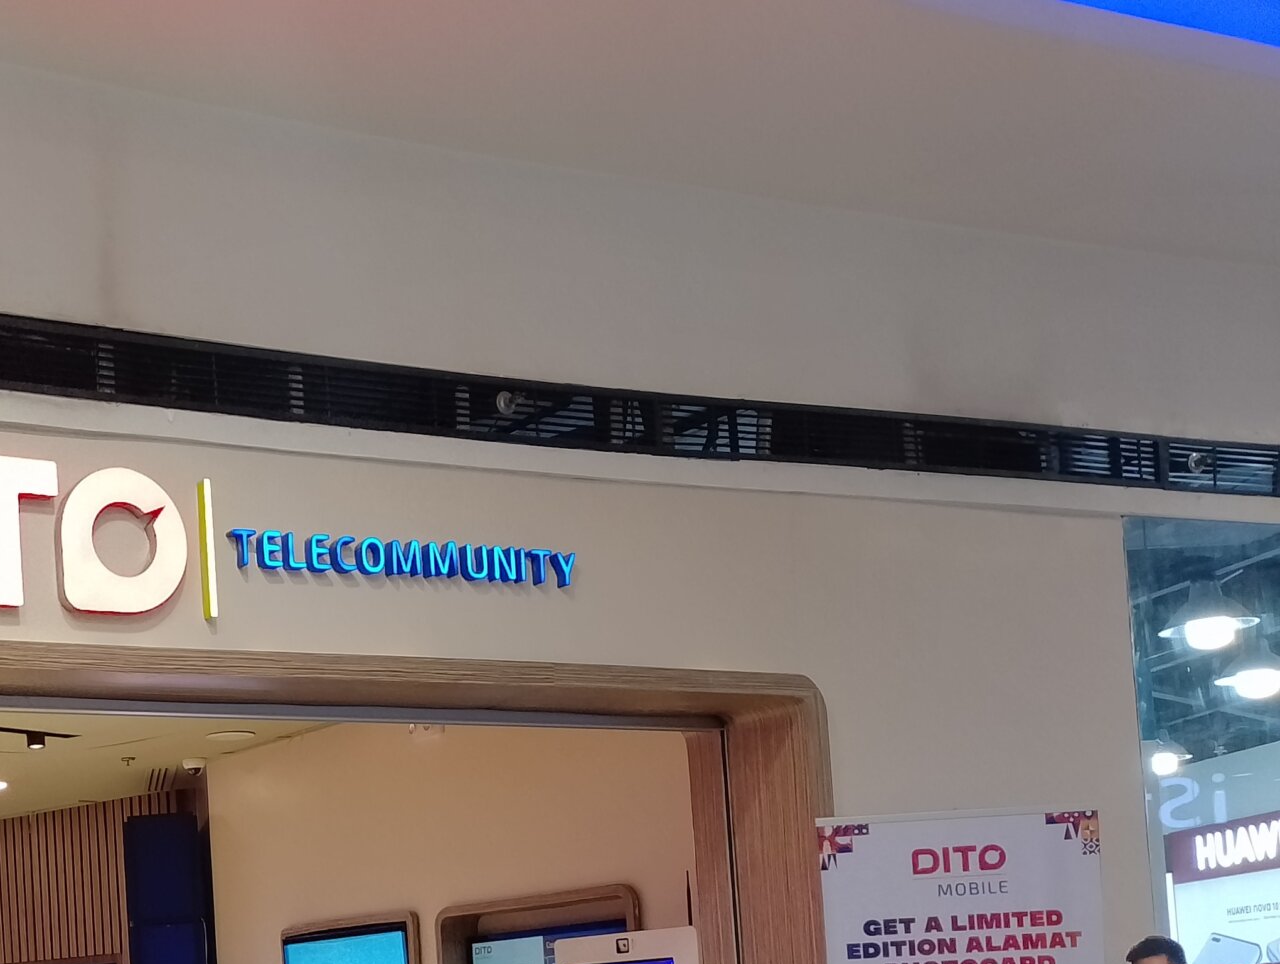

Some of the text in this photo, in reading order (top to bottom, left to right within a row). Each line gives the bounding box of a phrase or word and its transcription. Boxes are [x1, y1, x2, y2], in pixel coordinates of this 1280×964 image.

[226, 527, 577, 589] TELECOMMUNITY
[1195, 819, 1280, 870] HUAW
[911, 844, 1007, 875] DITO
[938, 880, 1009, 897] MOBILE
[863, 909, 1063, 936] GET A LIMITED
[474, 946, 492, 955] DITO
[846, 931, 1082, 960] EDITION ALAMAT
